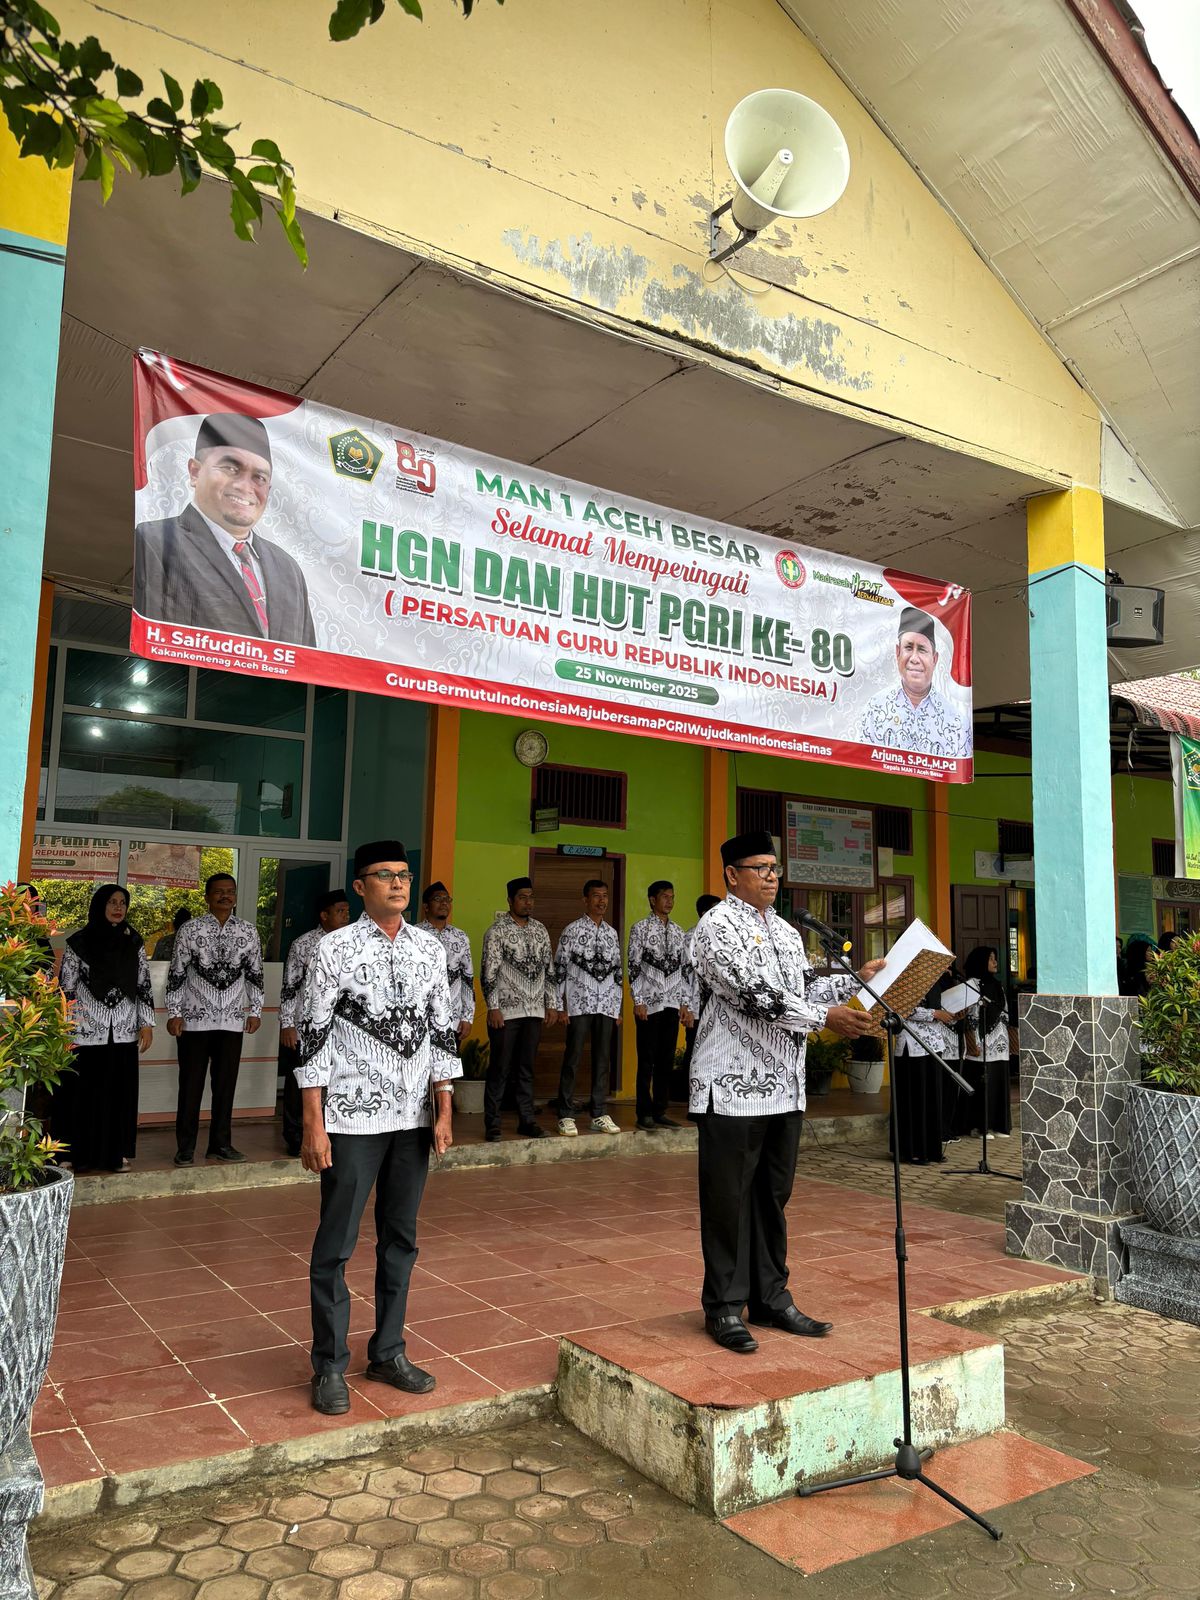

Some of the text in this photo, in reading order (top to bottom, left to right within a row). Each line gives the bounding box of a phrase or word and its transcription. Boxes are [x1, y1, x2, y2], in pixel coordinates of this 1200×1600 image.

[475, 467, 762, 568] MAN 1 ACEH BESAR
[490, 507, 593, 556] Selamat
[603, 536, 750, 597] Memperingati
[360, 519, 854, 676] HGN DAN HUT PGRI KE- 80
[146, 625, 296, 664] H. Saifuddin, SE
[150, 645, 289, 676] Kakankemenag Aceh Besar
[401, 595, 550, 645] PERSATUAN
[556, 629, 618, 658] GURU
[624, 643, 723, 679] REPUBLIK
[727, 664, 828, 699] INDONESIA
[575, 665, 699, 700] 25 November 2025
[385, 672, 833, 757] GuruBermutuIndonesiaMajubersamaPGRIWujudkanIndonesiaEmas
[870, 748, 906, 766] Arjuna,
[34, 849, 79, 858] REPUBLIK
